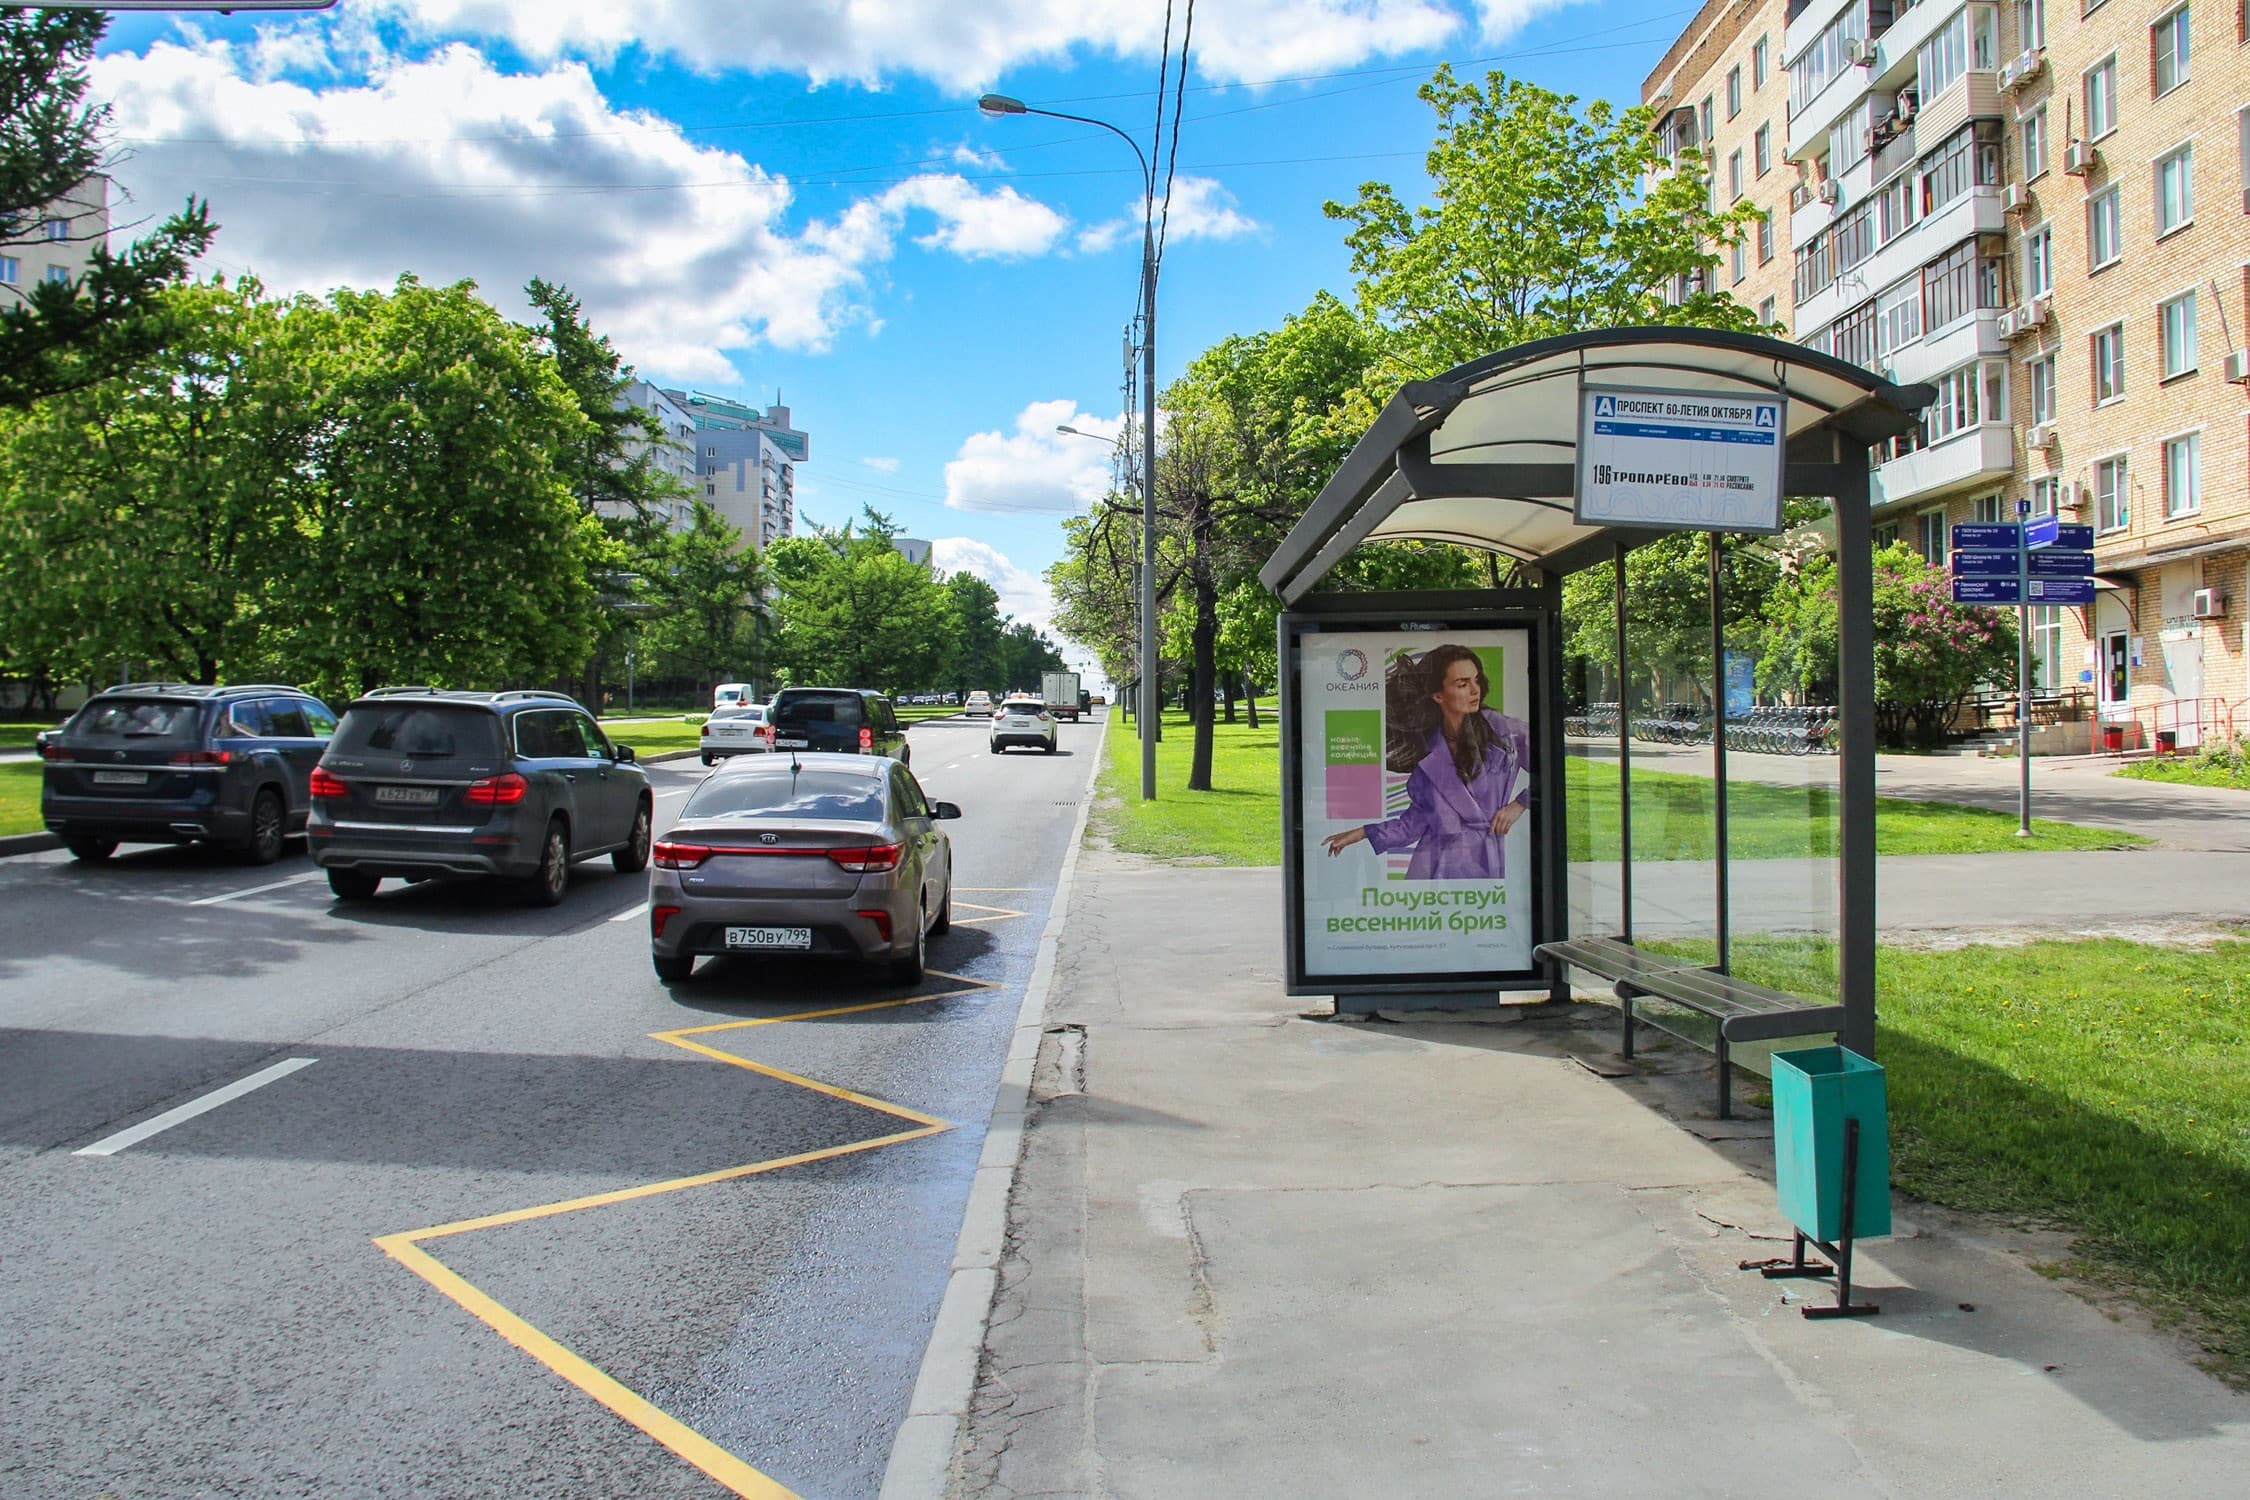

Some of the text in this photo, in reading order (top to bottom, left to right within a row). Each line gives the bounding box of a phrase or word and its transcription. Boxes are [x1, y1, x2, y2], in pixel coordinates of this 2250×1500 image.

[1617, 400, 1664, 414] ПРОСПЕКТ
[1666, 403, 1709, 417] 60-ЛЕТИЯ
[1711, 406, 1752, 420] ОКТЯБРЯ
[1593, 463, 1688, 486] 196 ТРОПАРЁВО
[1326, 682, 1379, 691] ОКЕАНИЯ
[761, 834, 777, 844] KIA
[1362, 885, 1507, 911] Почувствуй
[1326, 910, 1507, 935] весенний бриз
[729, 929, 807, 944] В750ВУ 799
